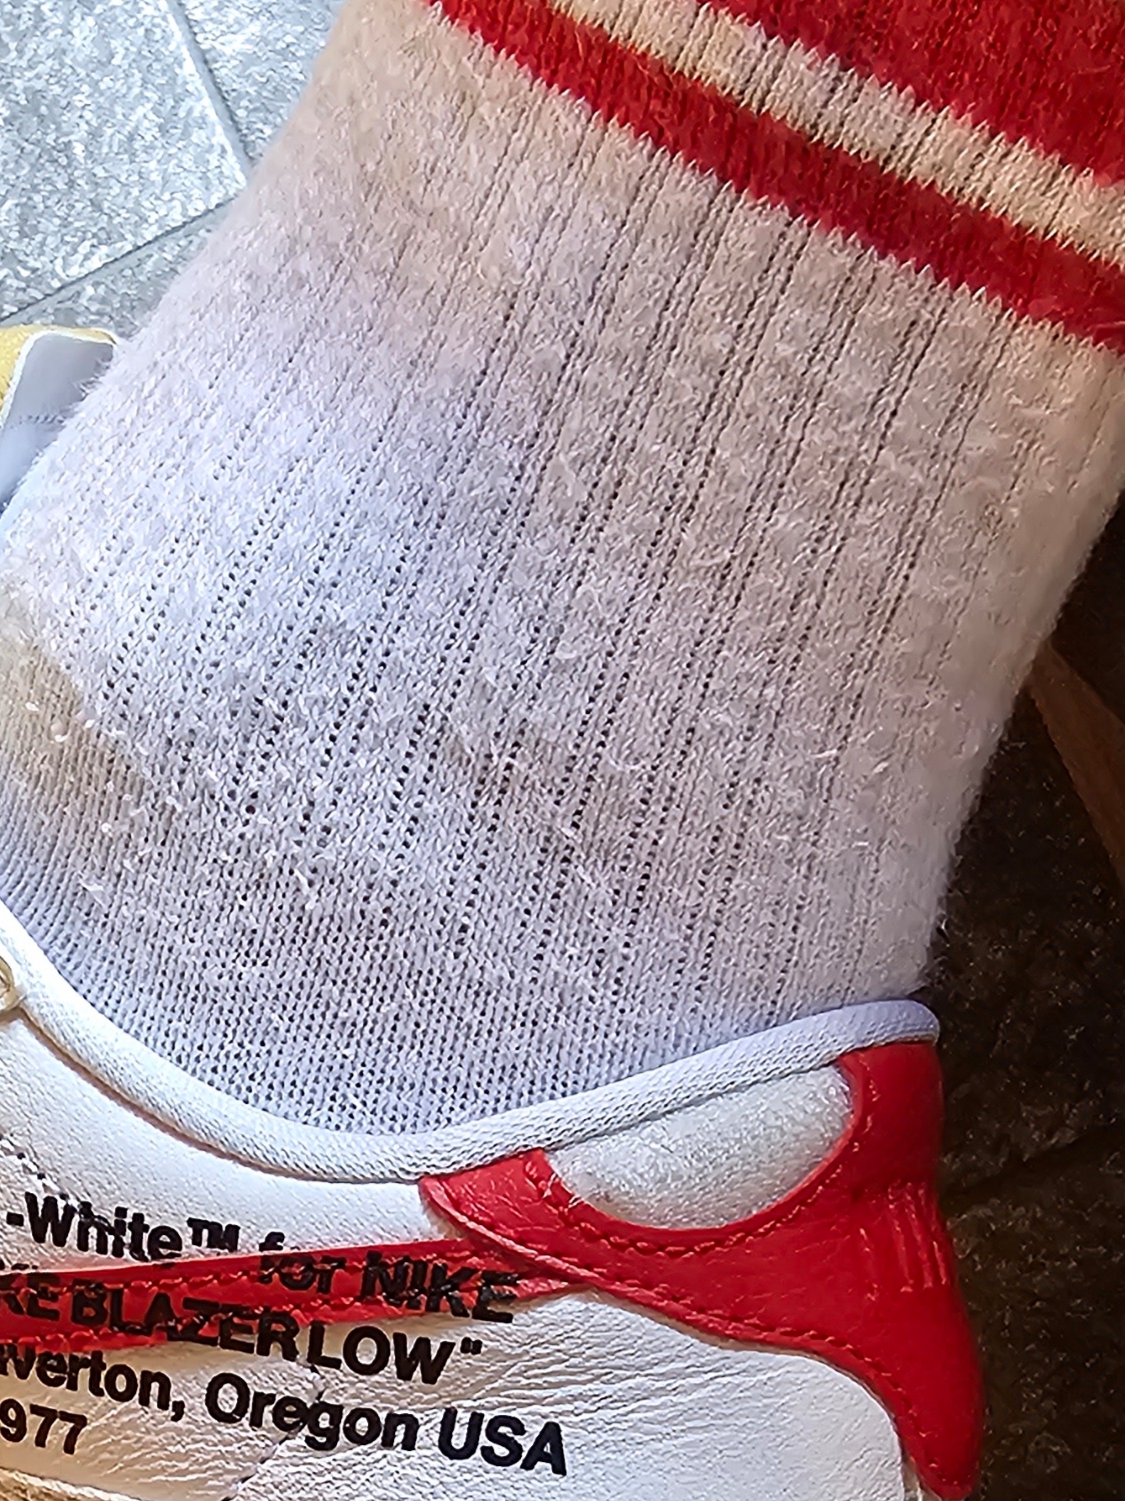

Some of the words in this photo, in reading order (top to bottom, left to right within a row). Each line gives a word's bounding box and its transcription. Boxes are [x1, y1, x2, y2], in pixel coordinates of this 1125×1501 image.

[258, 1231, 347, 1293] for
[361, 1250, 521, 1324] NIKE
[204, 1371, 420, 1452] Oregon
[437, 1405, 568, 1477] USA
